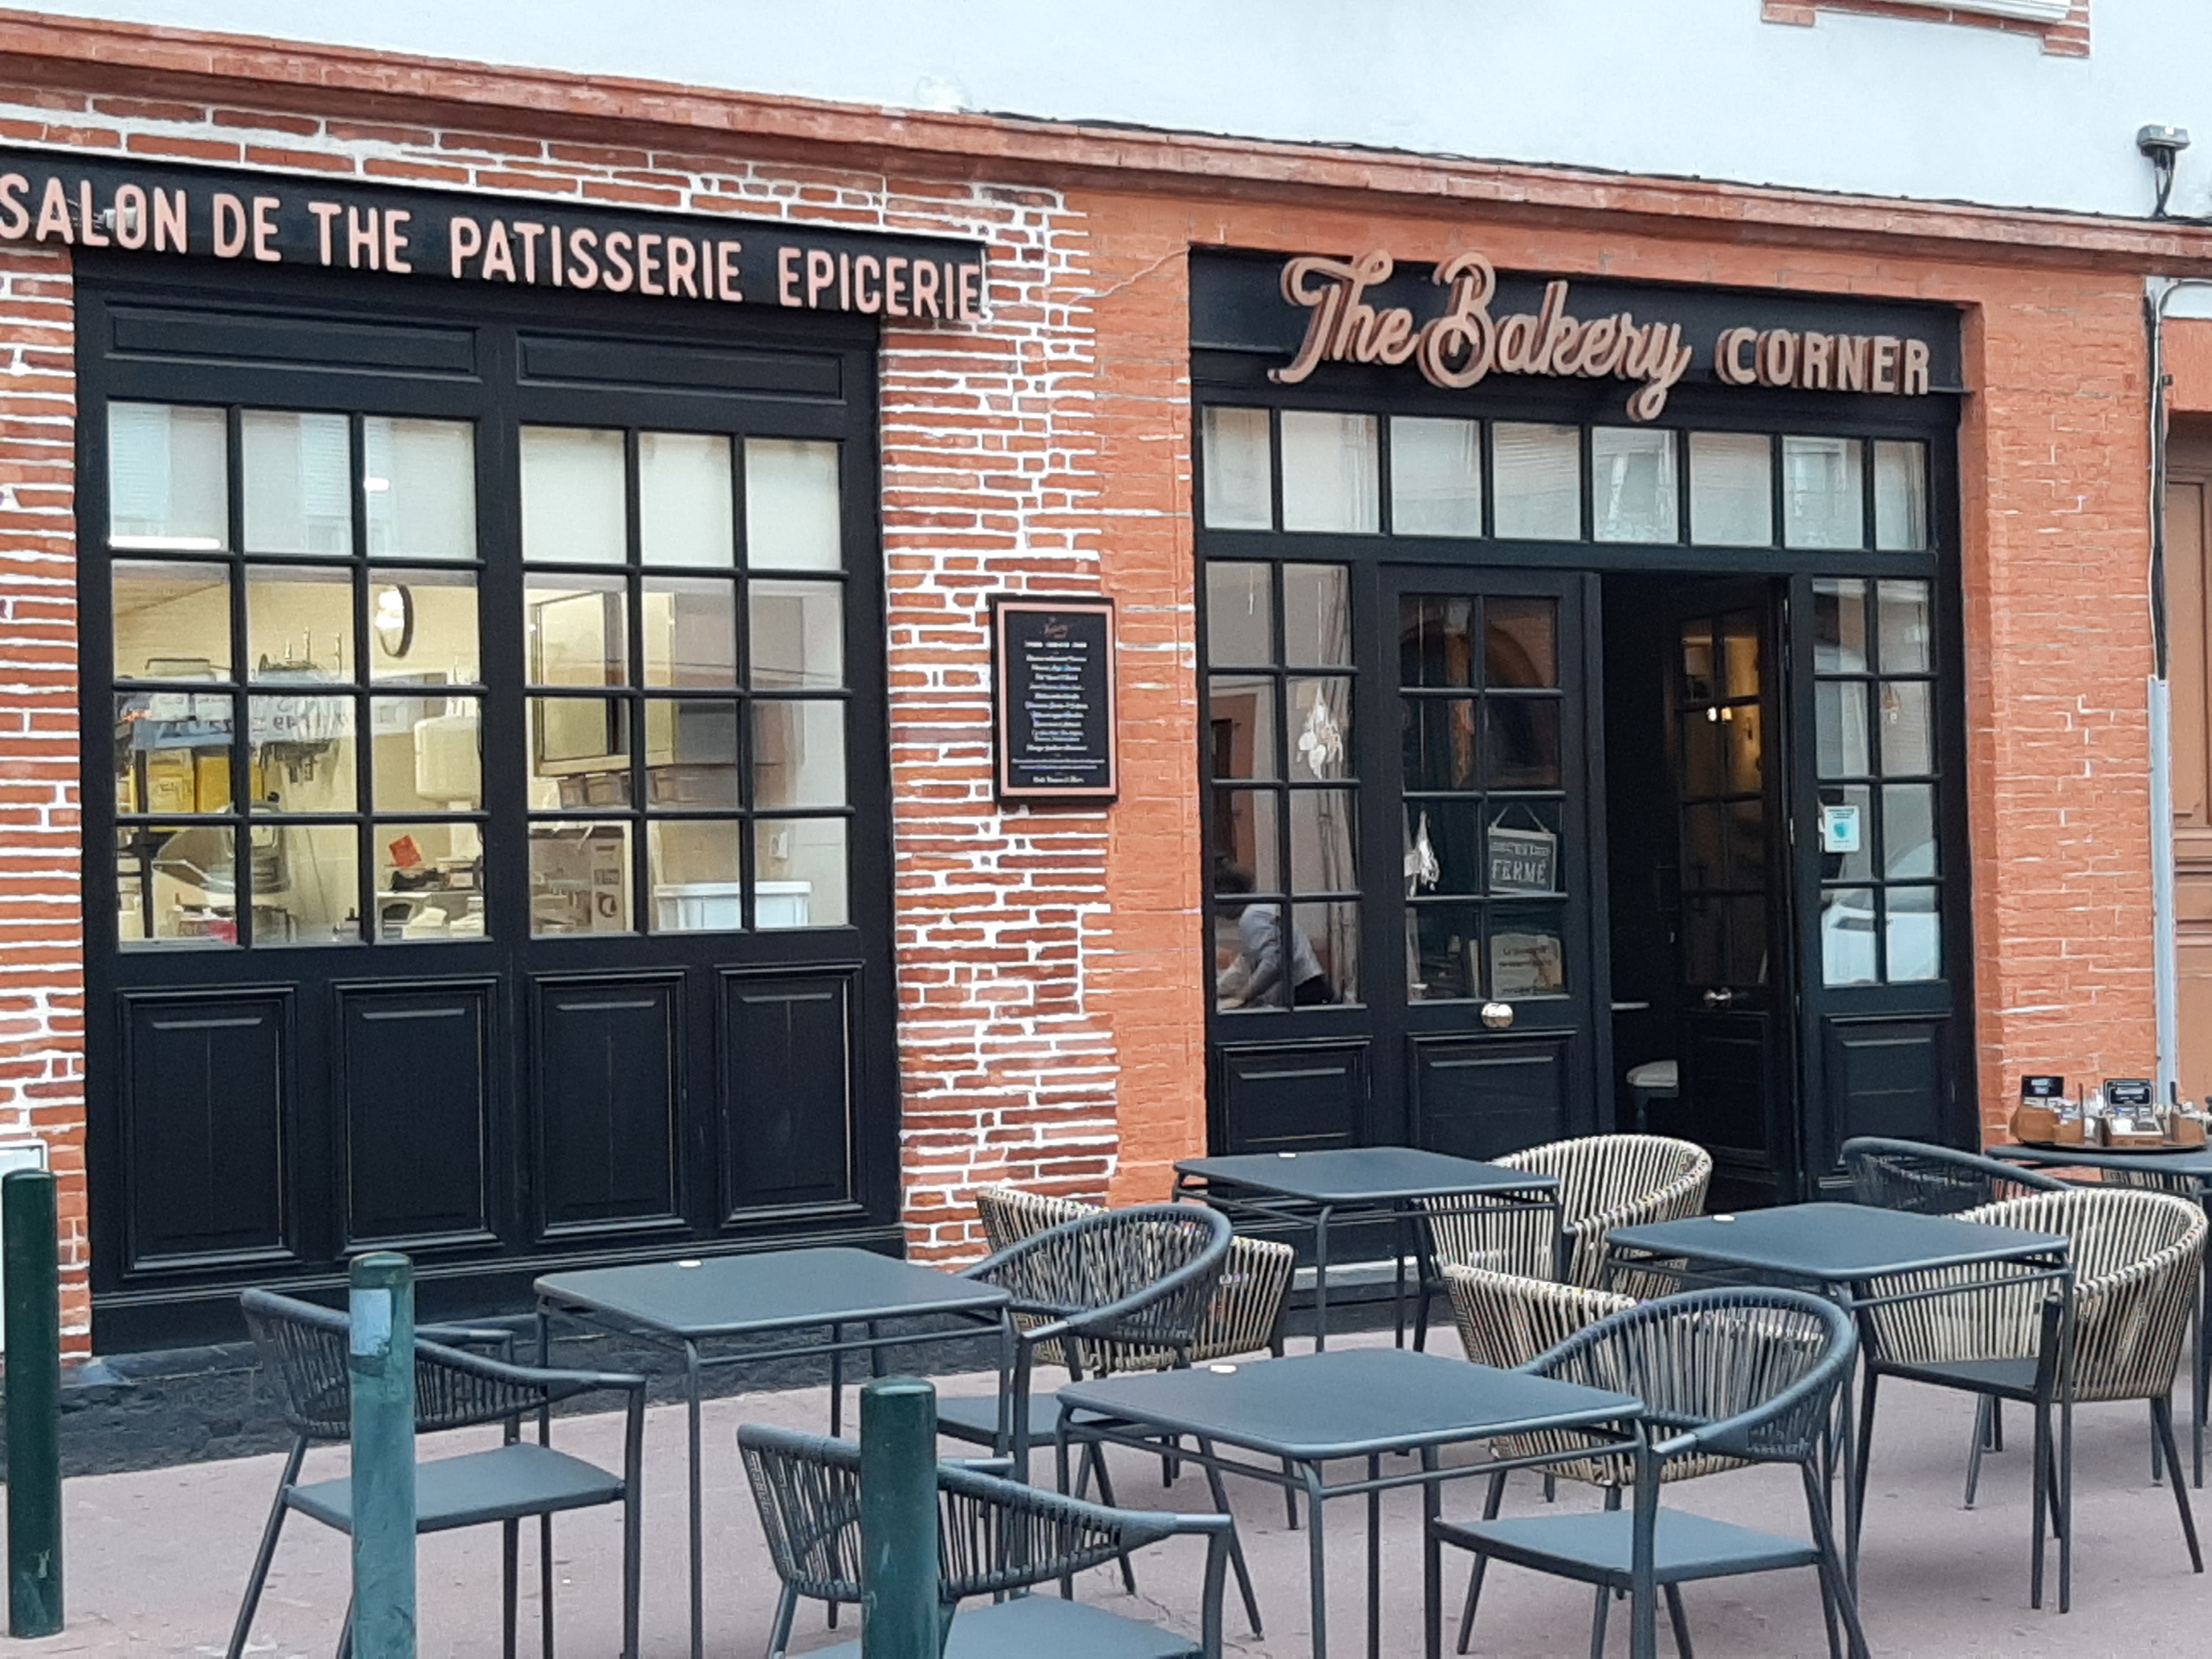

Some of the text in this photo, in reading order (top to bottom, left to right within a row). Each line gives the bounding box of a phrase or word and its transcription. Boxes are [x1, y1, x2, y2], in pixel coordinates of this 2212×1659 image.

[0, 173, 980, 321] SALON DE THE PATISSERIE EPICERIE
[1267, 249, 1930, 421] The Bakery CORNER
